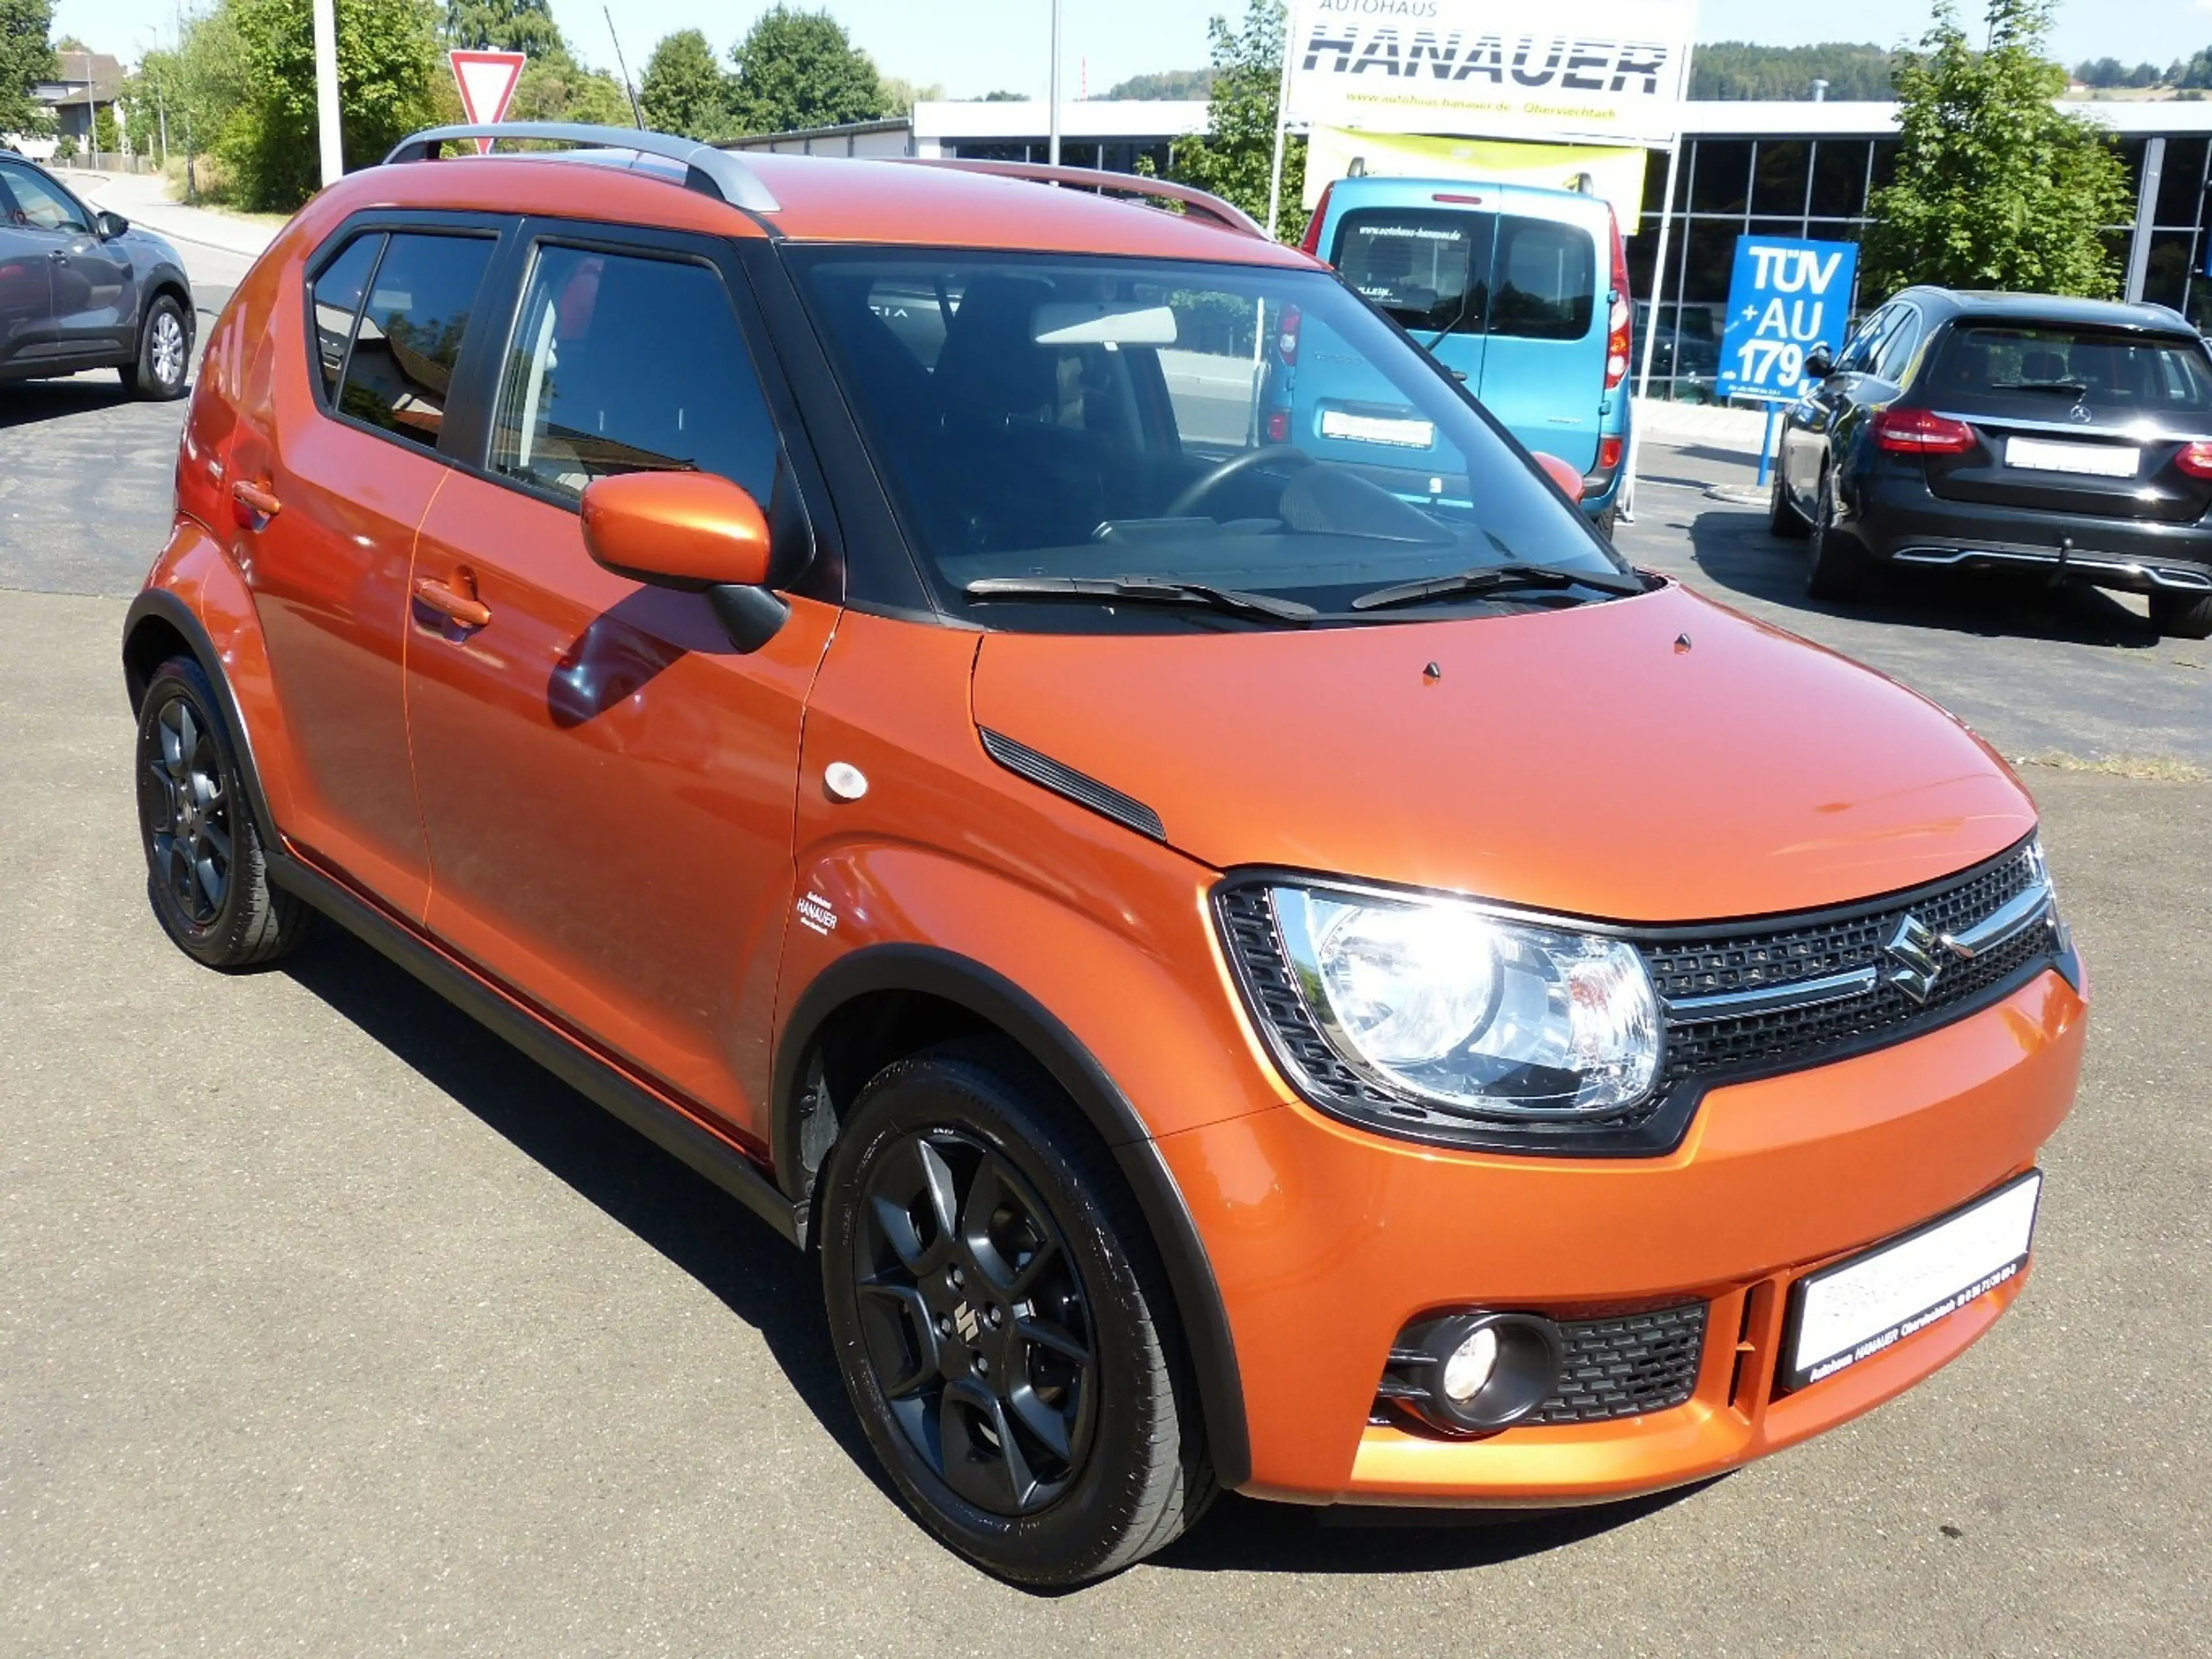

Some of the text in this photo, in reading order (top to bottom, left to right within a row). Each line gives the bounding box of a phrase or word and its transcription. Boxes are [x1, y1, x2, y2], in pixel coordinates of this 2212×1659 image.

[1319, 0, 1438, 17] AUTOHAUS
[1301, 24, 1669, 94] HANAUER
[1748, 245, 1843, 295] TÜV
[1755, 297, 1824, 342] AU
